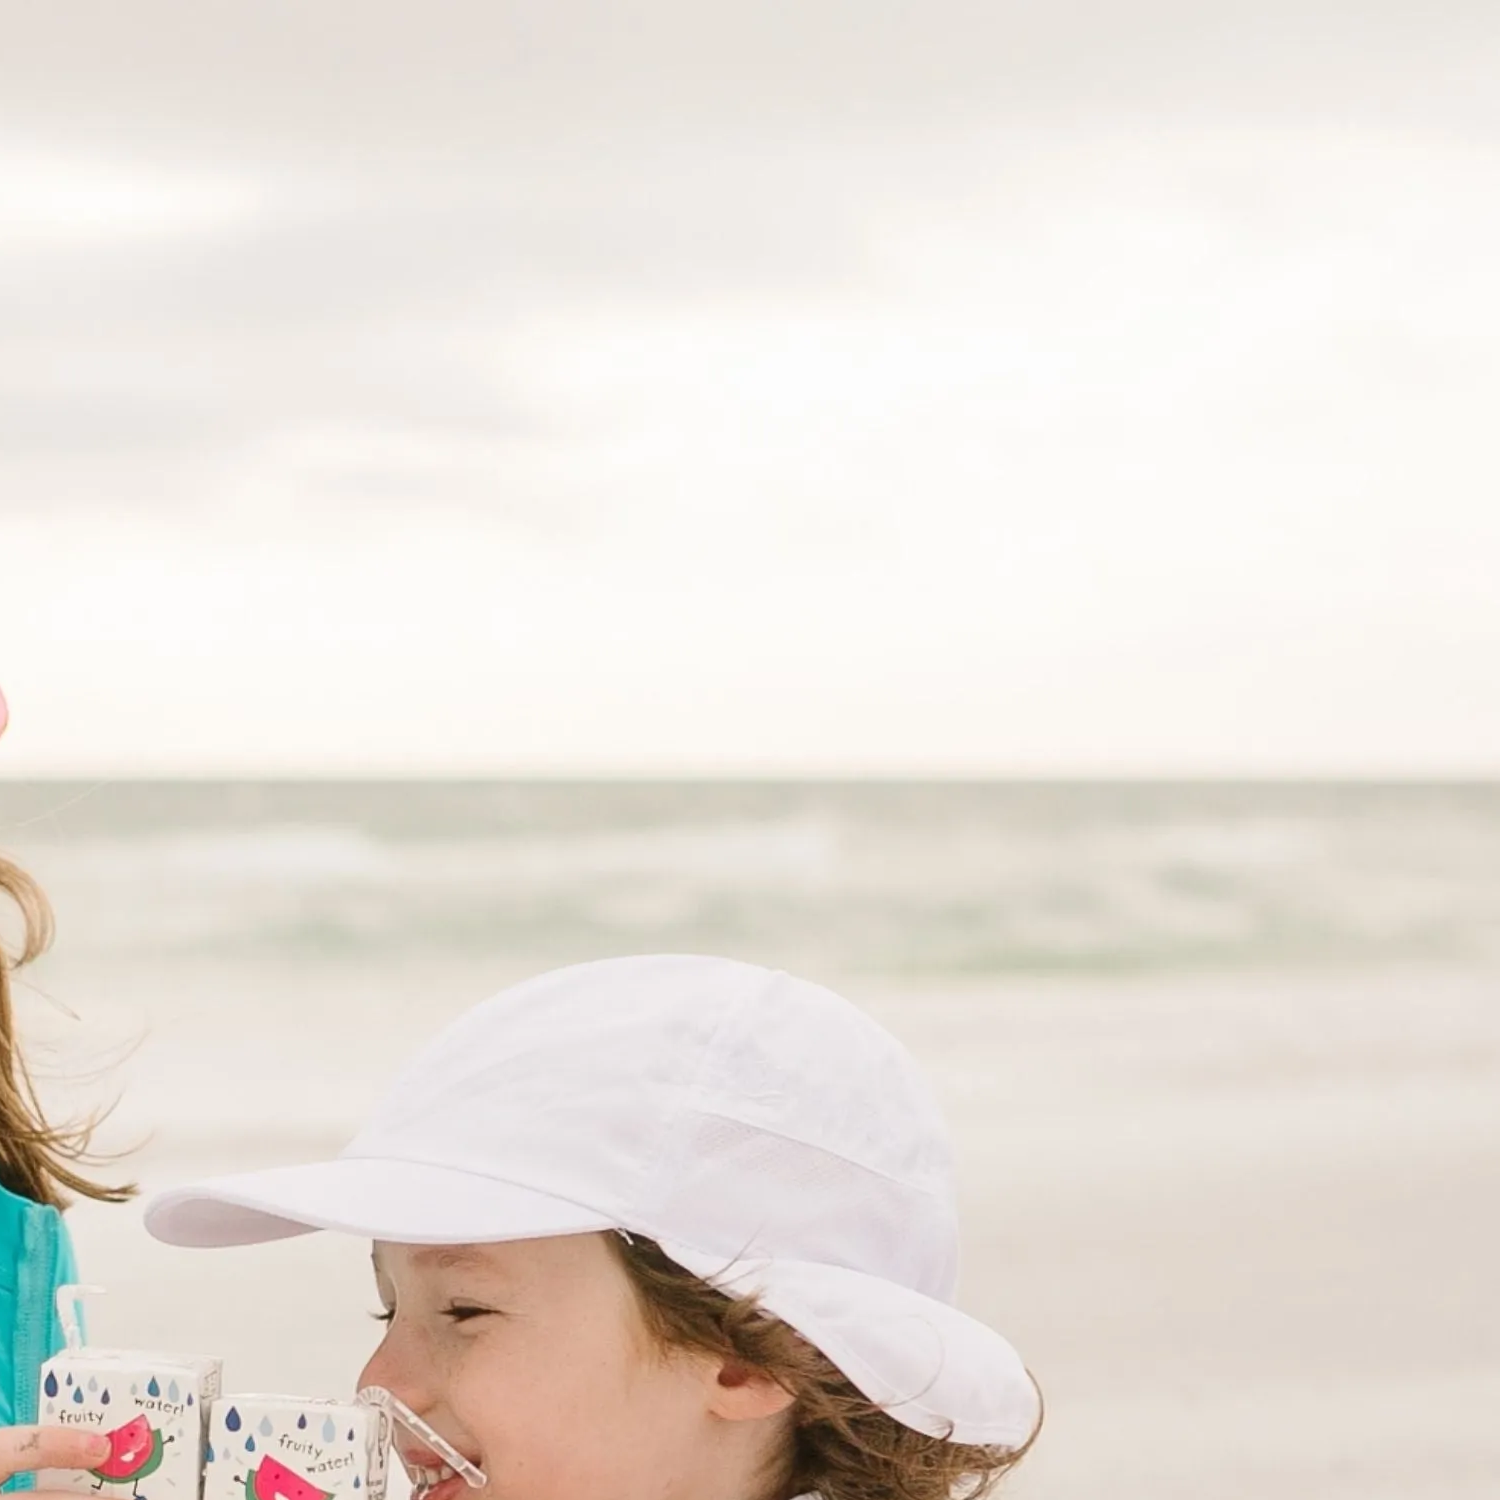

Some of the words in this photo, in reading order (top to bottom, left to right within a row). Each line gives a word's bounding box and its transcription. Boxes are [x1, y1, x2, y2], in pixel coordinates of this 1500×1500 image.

[59, 1410, 104, 1425] fruity
[135, 1398, 185, 1415] water!
[278, 1433, 323, 1459] fruity
[306, 1452, 355, 1472] water!
